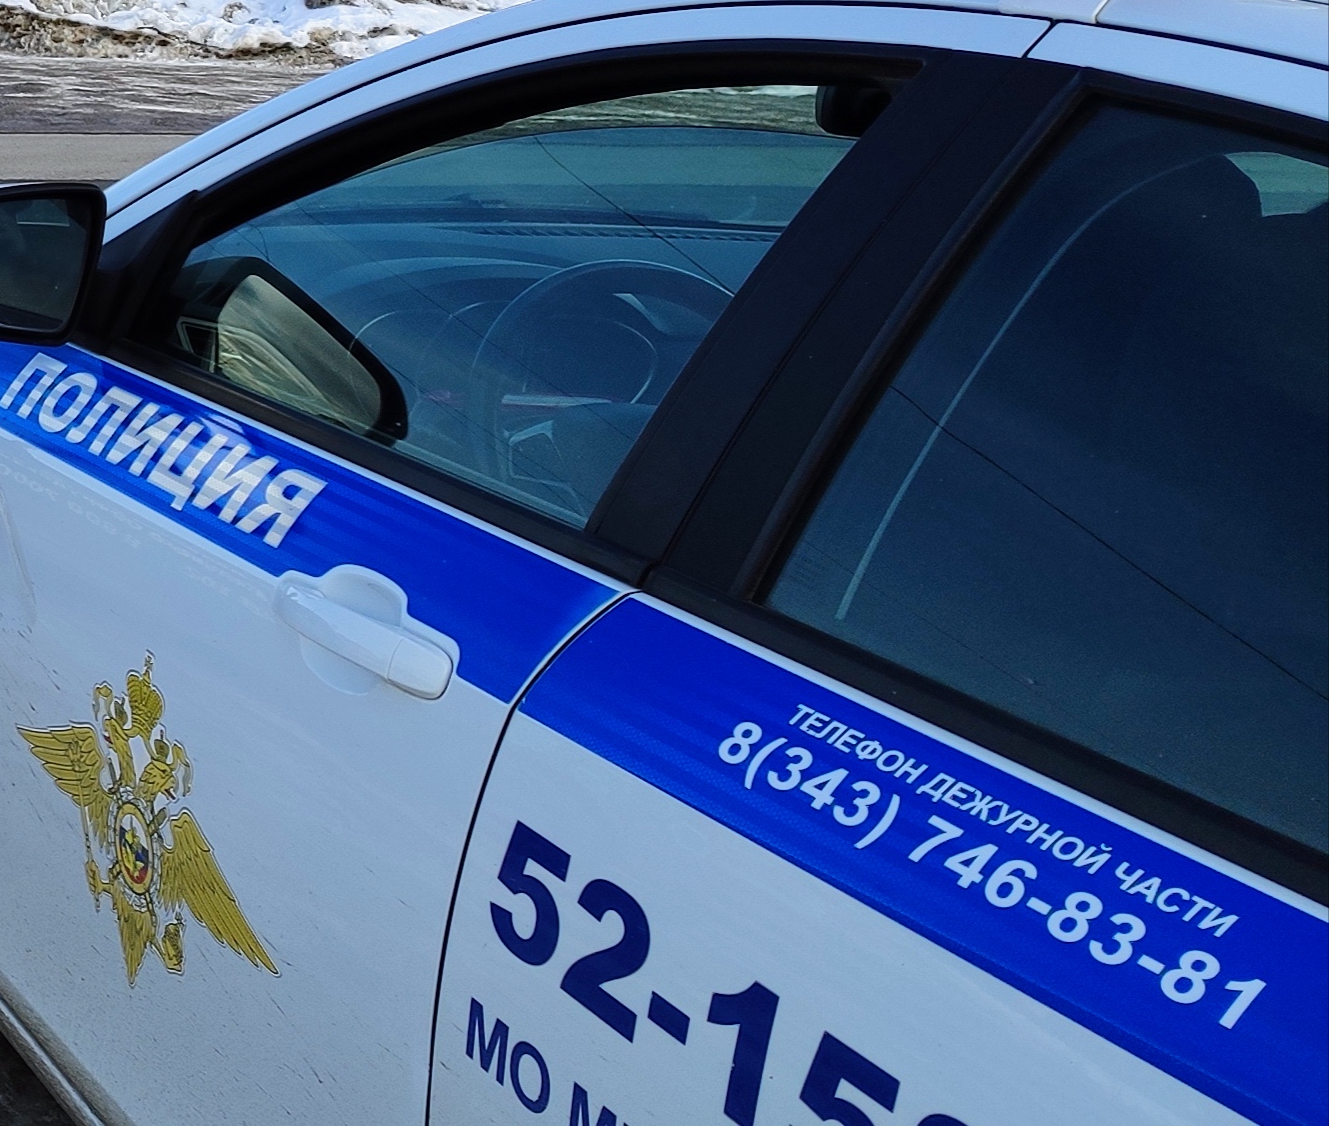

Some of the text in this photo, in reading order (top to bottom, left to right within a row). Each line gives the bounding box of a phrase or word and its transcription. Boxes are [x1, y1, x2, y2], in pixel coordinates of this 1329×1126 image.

[717, 721, 1268, 1031] 8(343) 746-83-81
[789, 703, 1239, 938] ТЕЛЕФОН ДЕЖУРНОЙ ЧАСТИ
[465, 996, 551, 1115] МО
[489, 819, 981, 1126] 52-15
